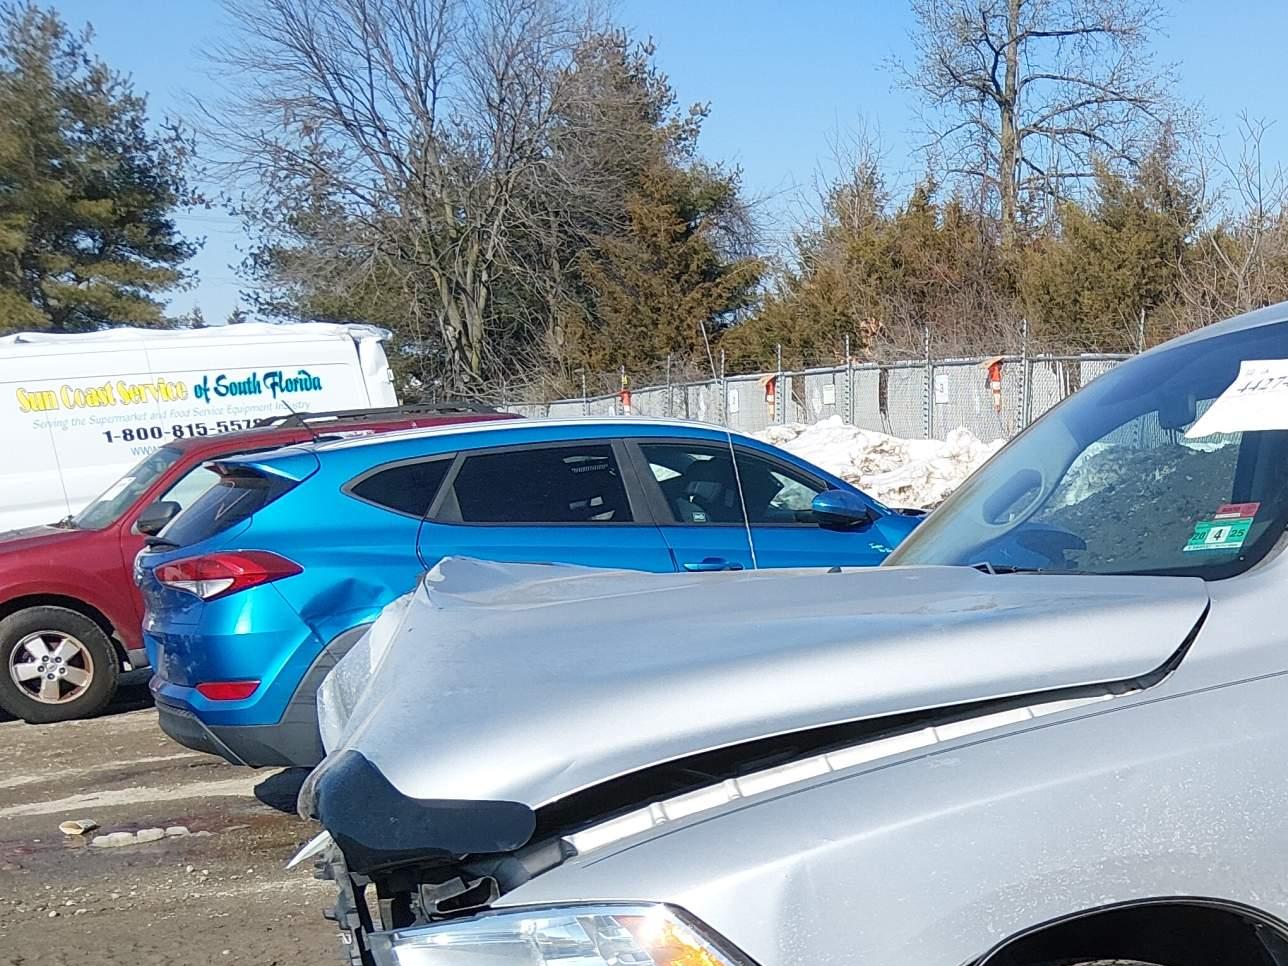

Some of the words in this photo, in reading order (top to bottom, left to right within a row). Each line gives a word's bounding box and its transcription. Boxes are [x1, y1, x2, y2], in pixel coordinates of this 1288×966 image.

[16, 387, 59, 413] Sun
[60, 381, 117, 409] Coast
[116, 377, 188, 405] Service
[193, 375, 210, 404] of
[214, 372, 262, 397] South
[263, 369, 323, 399] Florida
[33, 418, 68, 431] Serving
[71, 416, 86, 427] the
[89, 411, 147, 427] Supermarket
[149, 409, 167, 420] and
[170, 408, 190, 419] Food
[193, 406, 224, 417] Service
[226, 402, 272, 417] Equipment
[1213, 529, 1224, 541] 4
[1229, 529, 1245, 538] 25
